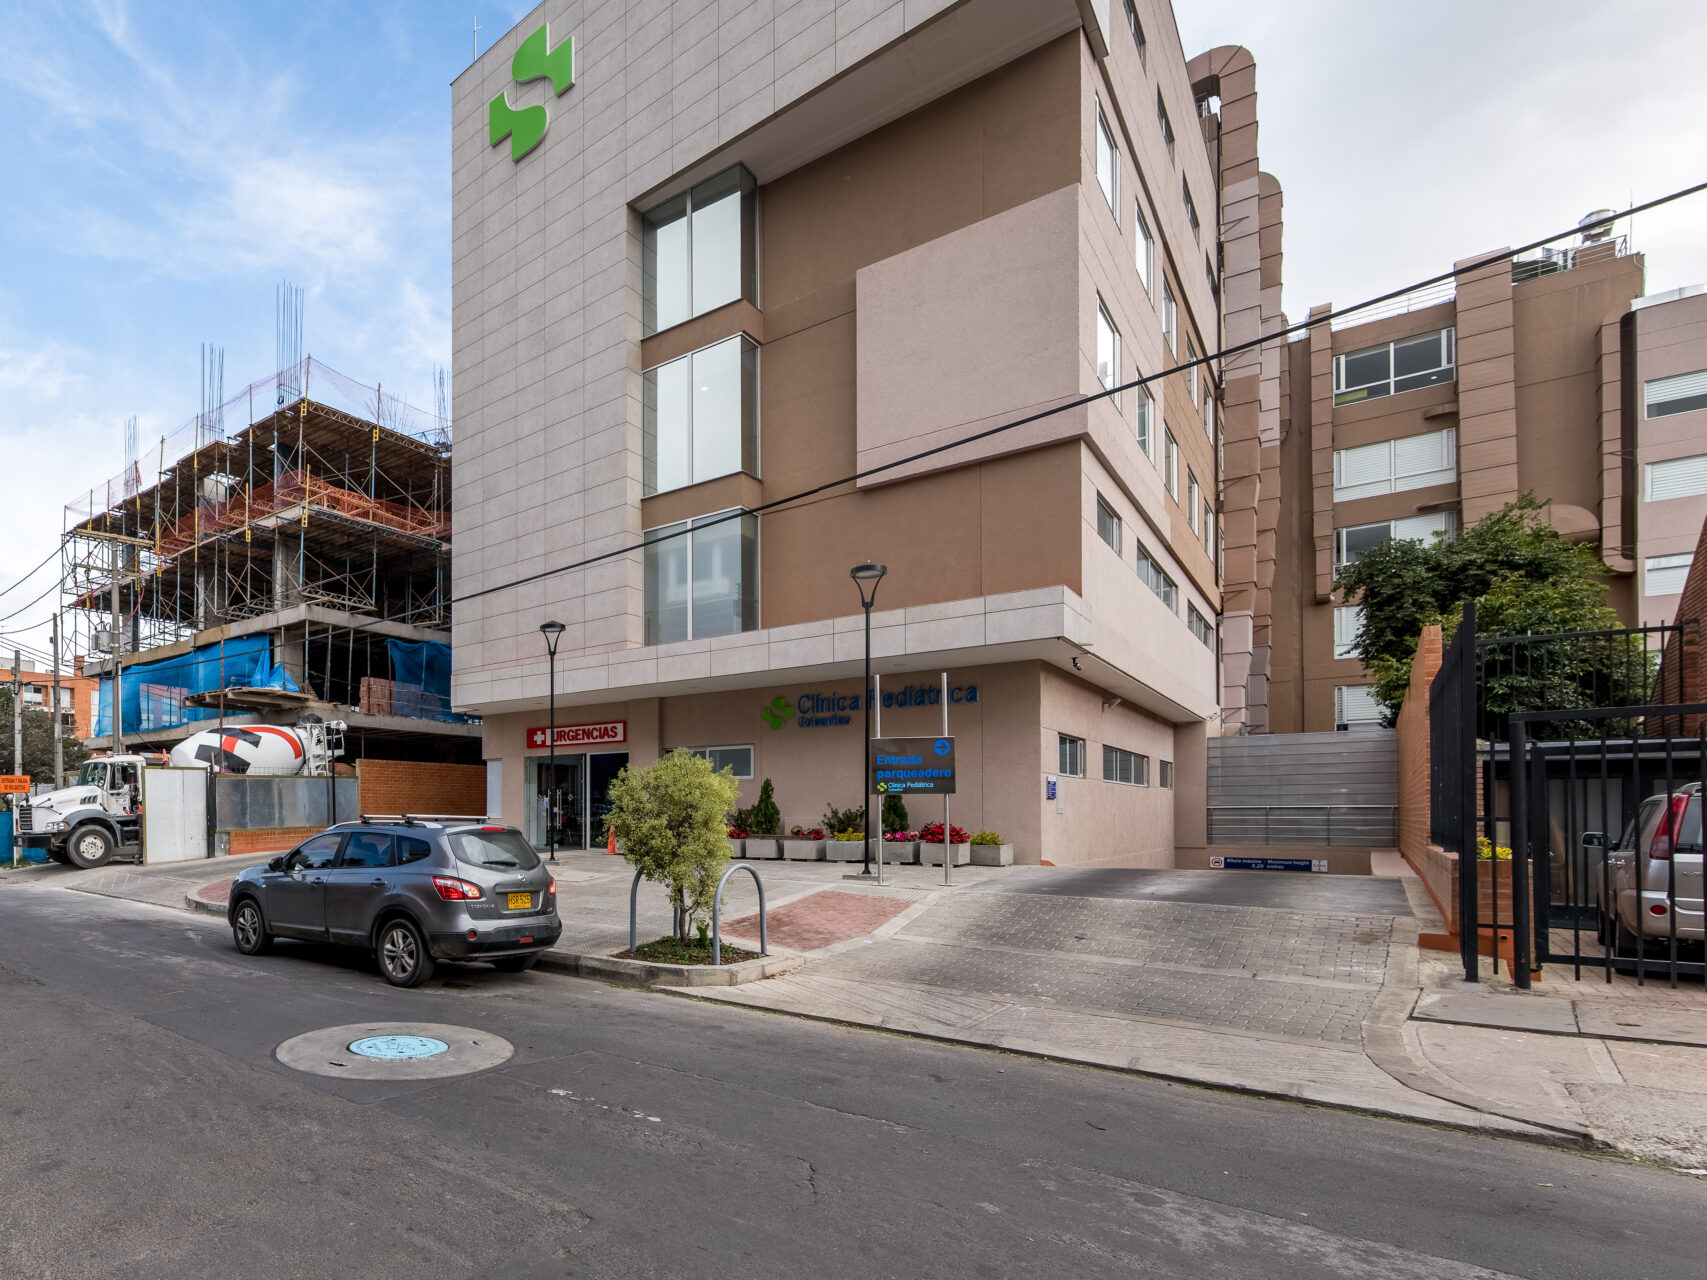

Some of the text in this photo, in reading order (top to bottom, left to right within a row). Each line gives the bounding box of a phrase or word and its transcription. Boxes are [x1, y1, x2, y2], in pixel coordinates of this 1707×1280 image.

[798, 692, 860, 714] Clínica
[876, 754, 923, 765] Entrada
[877, 768, 952, 780] parqueadero
